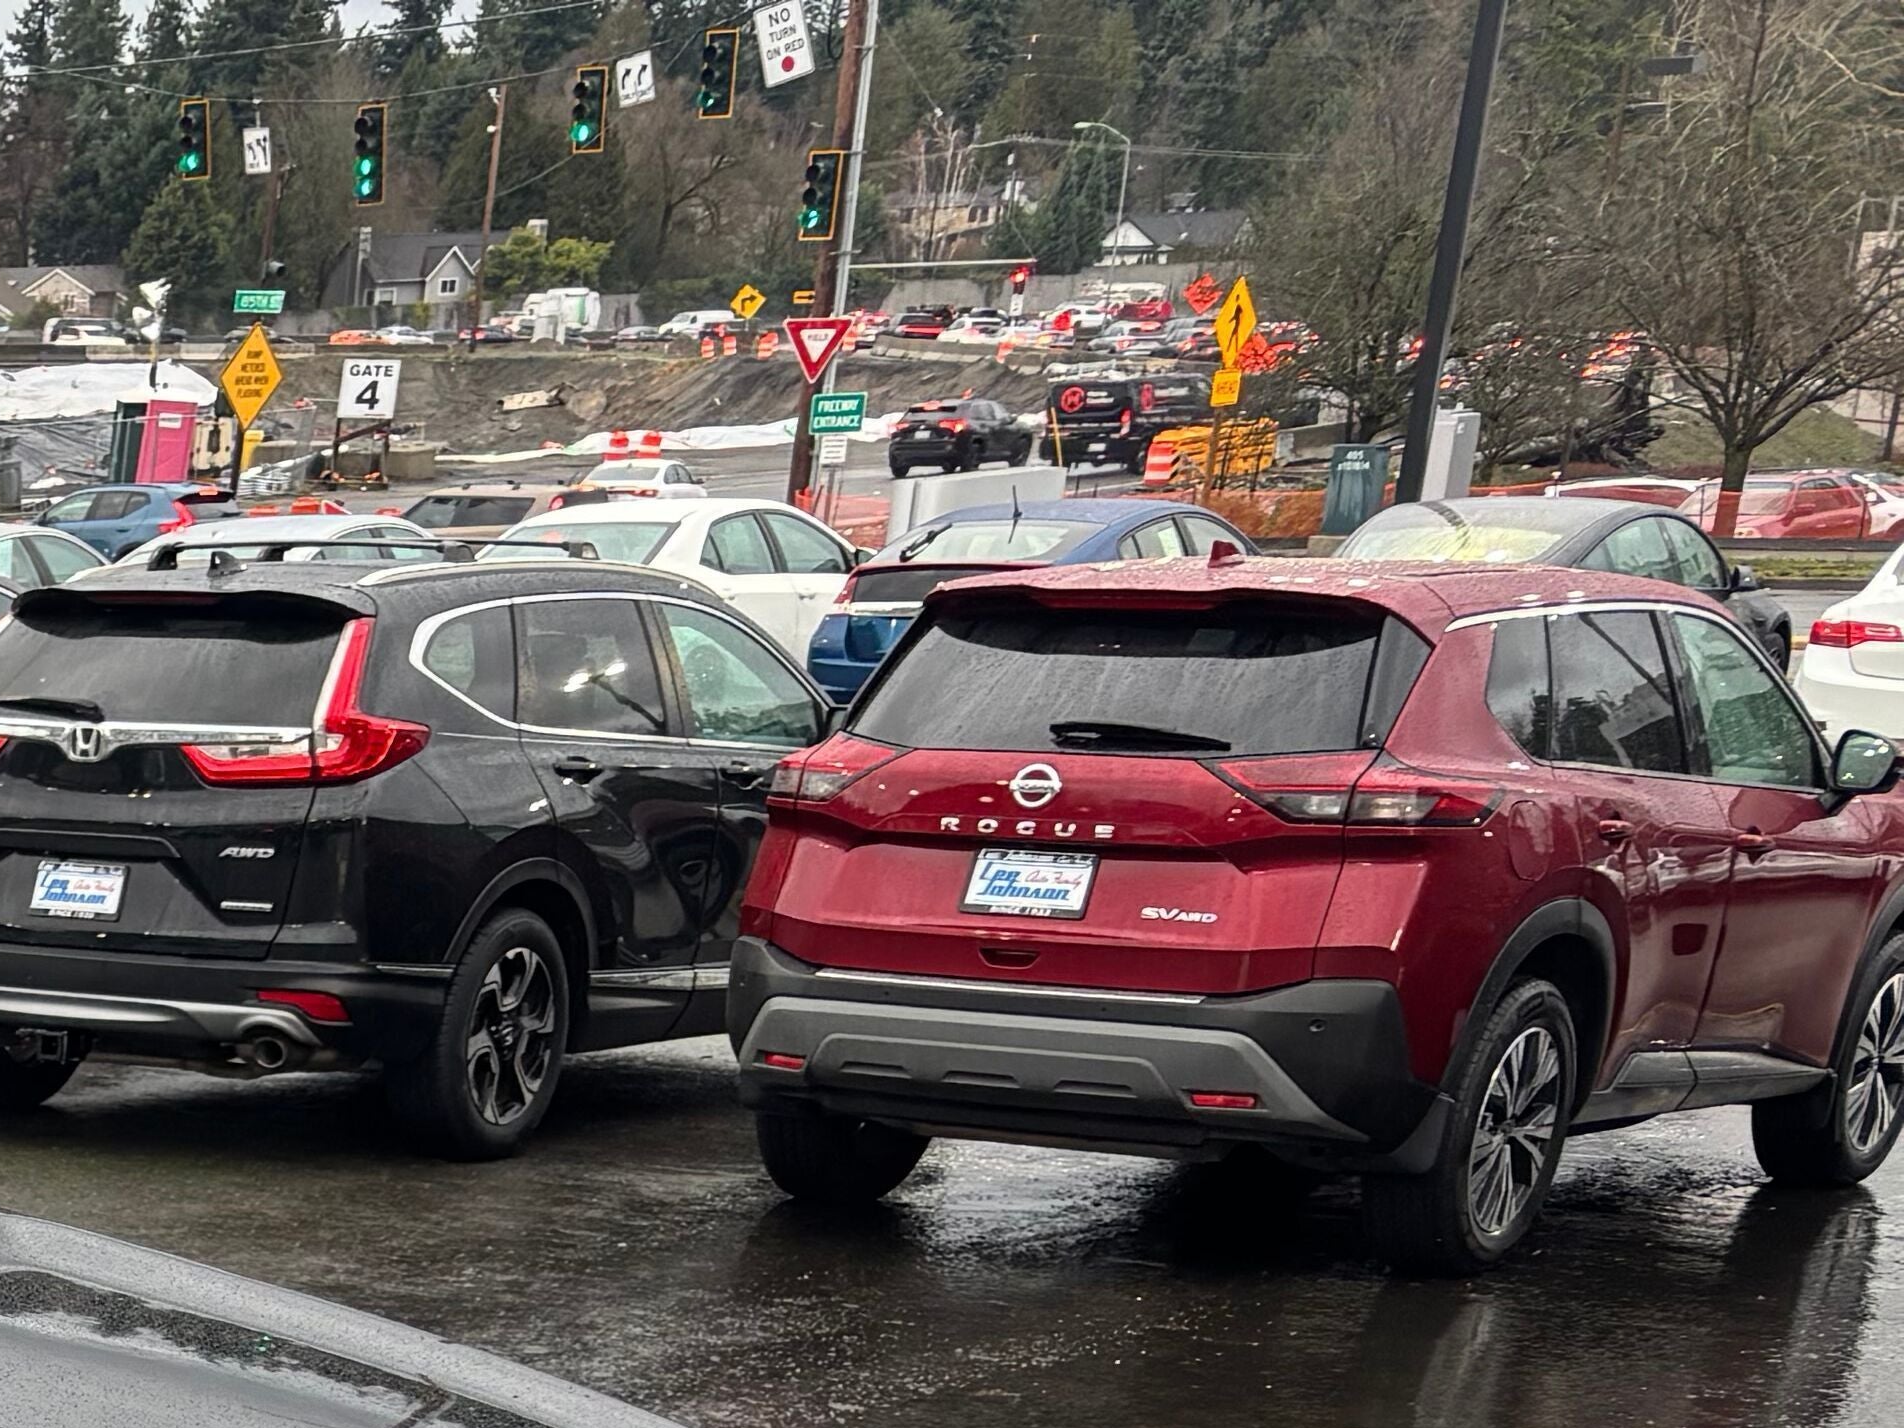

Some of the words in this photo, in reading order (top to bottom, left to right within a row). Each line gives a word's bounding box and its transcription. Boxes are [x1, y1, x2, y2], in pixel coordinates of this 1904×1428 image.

[769, 8, 790, 27] NO
[769, 24, 796, 42] TURN
[767, 47, 781, 60] ON
[785, 38, 804, 52] RED
[350, 364, 394, 377] GATE
[355, 380, 380, 410] 4
[818, 400, 860, 413] FREEWAY
[813, 415, 861, 429] ENTRANCE
[941, 816, 1115, 839] ROGUE
[219, 846, 275, 858] AWD
[979, 861, 1021, 882] Lee
[41, 873, 70, 891] Lee
[976, 881, 1070, 900] Johnson
[39, 888, 107, 904] Johnson
[1141, 907, 1180, 920] SV
[1173, 912, 1218, 923] AWD
